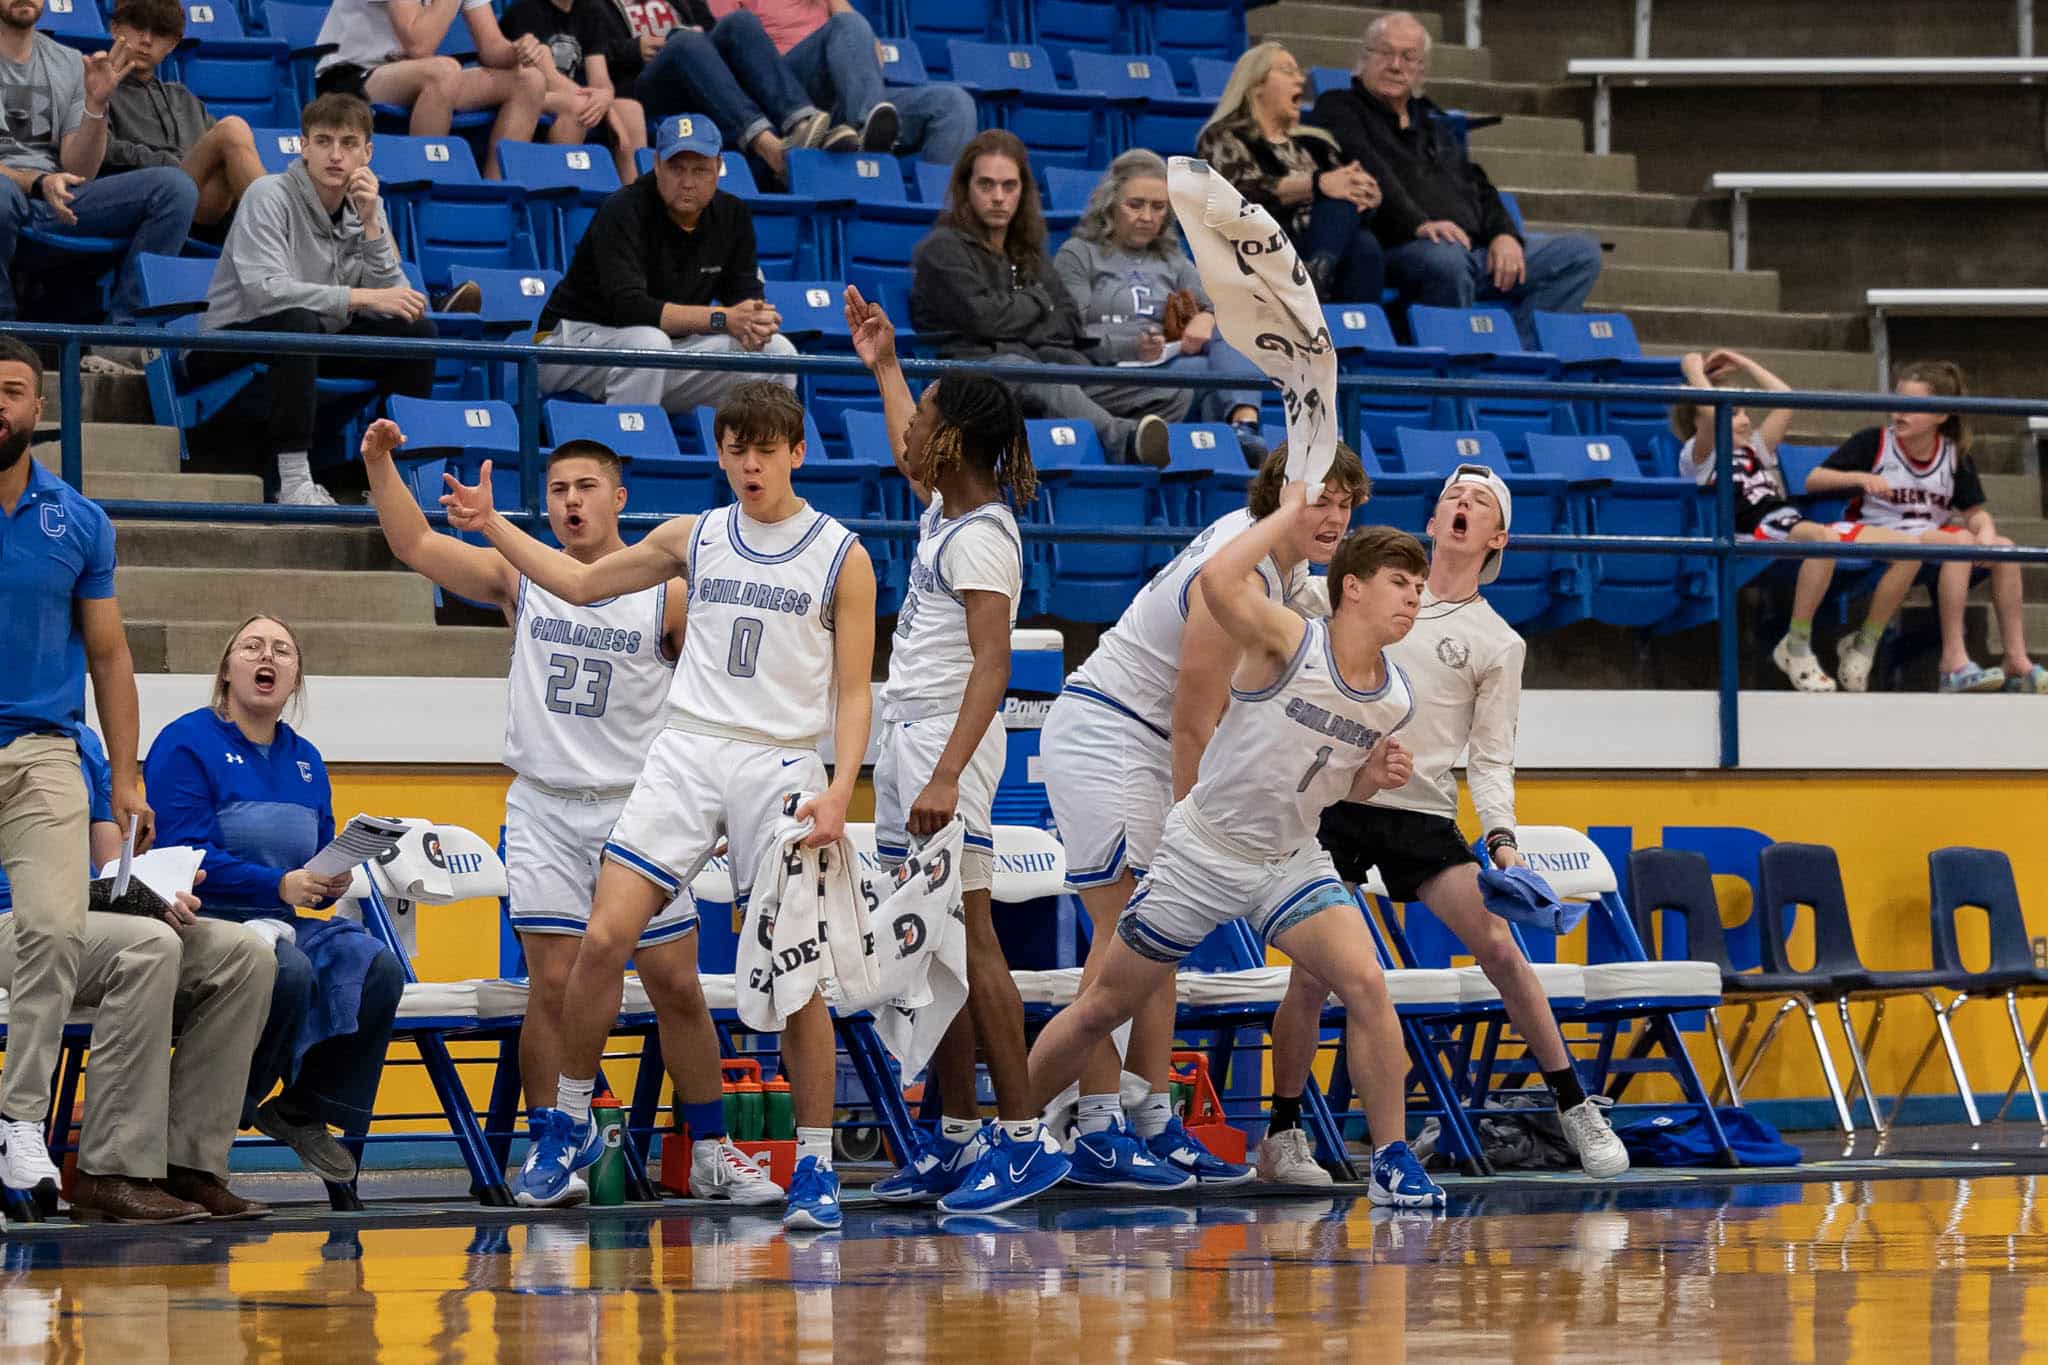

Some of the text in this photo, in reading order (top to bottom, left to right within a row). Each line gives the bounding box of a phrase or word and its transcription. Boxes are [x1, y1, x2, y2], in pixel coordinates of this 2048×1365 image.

[678, 118, 693, 138] B
[1131, 286, 1155, 315] C
[40, 503, 66, 538] C
[700, 578, 812, 616] CHILDRESS
[531, 616, 642, 654] CHILDRESS
[727, 616, 763, 678] 0
[545, 653, 613, 718] 23
[1285, 697, 1382, 750] CHILDRESS
[296, 761, 313, 783] C
[1296, 746, 1333, 792] 1
